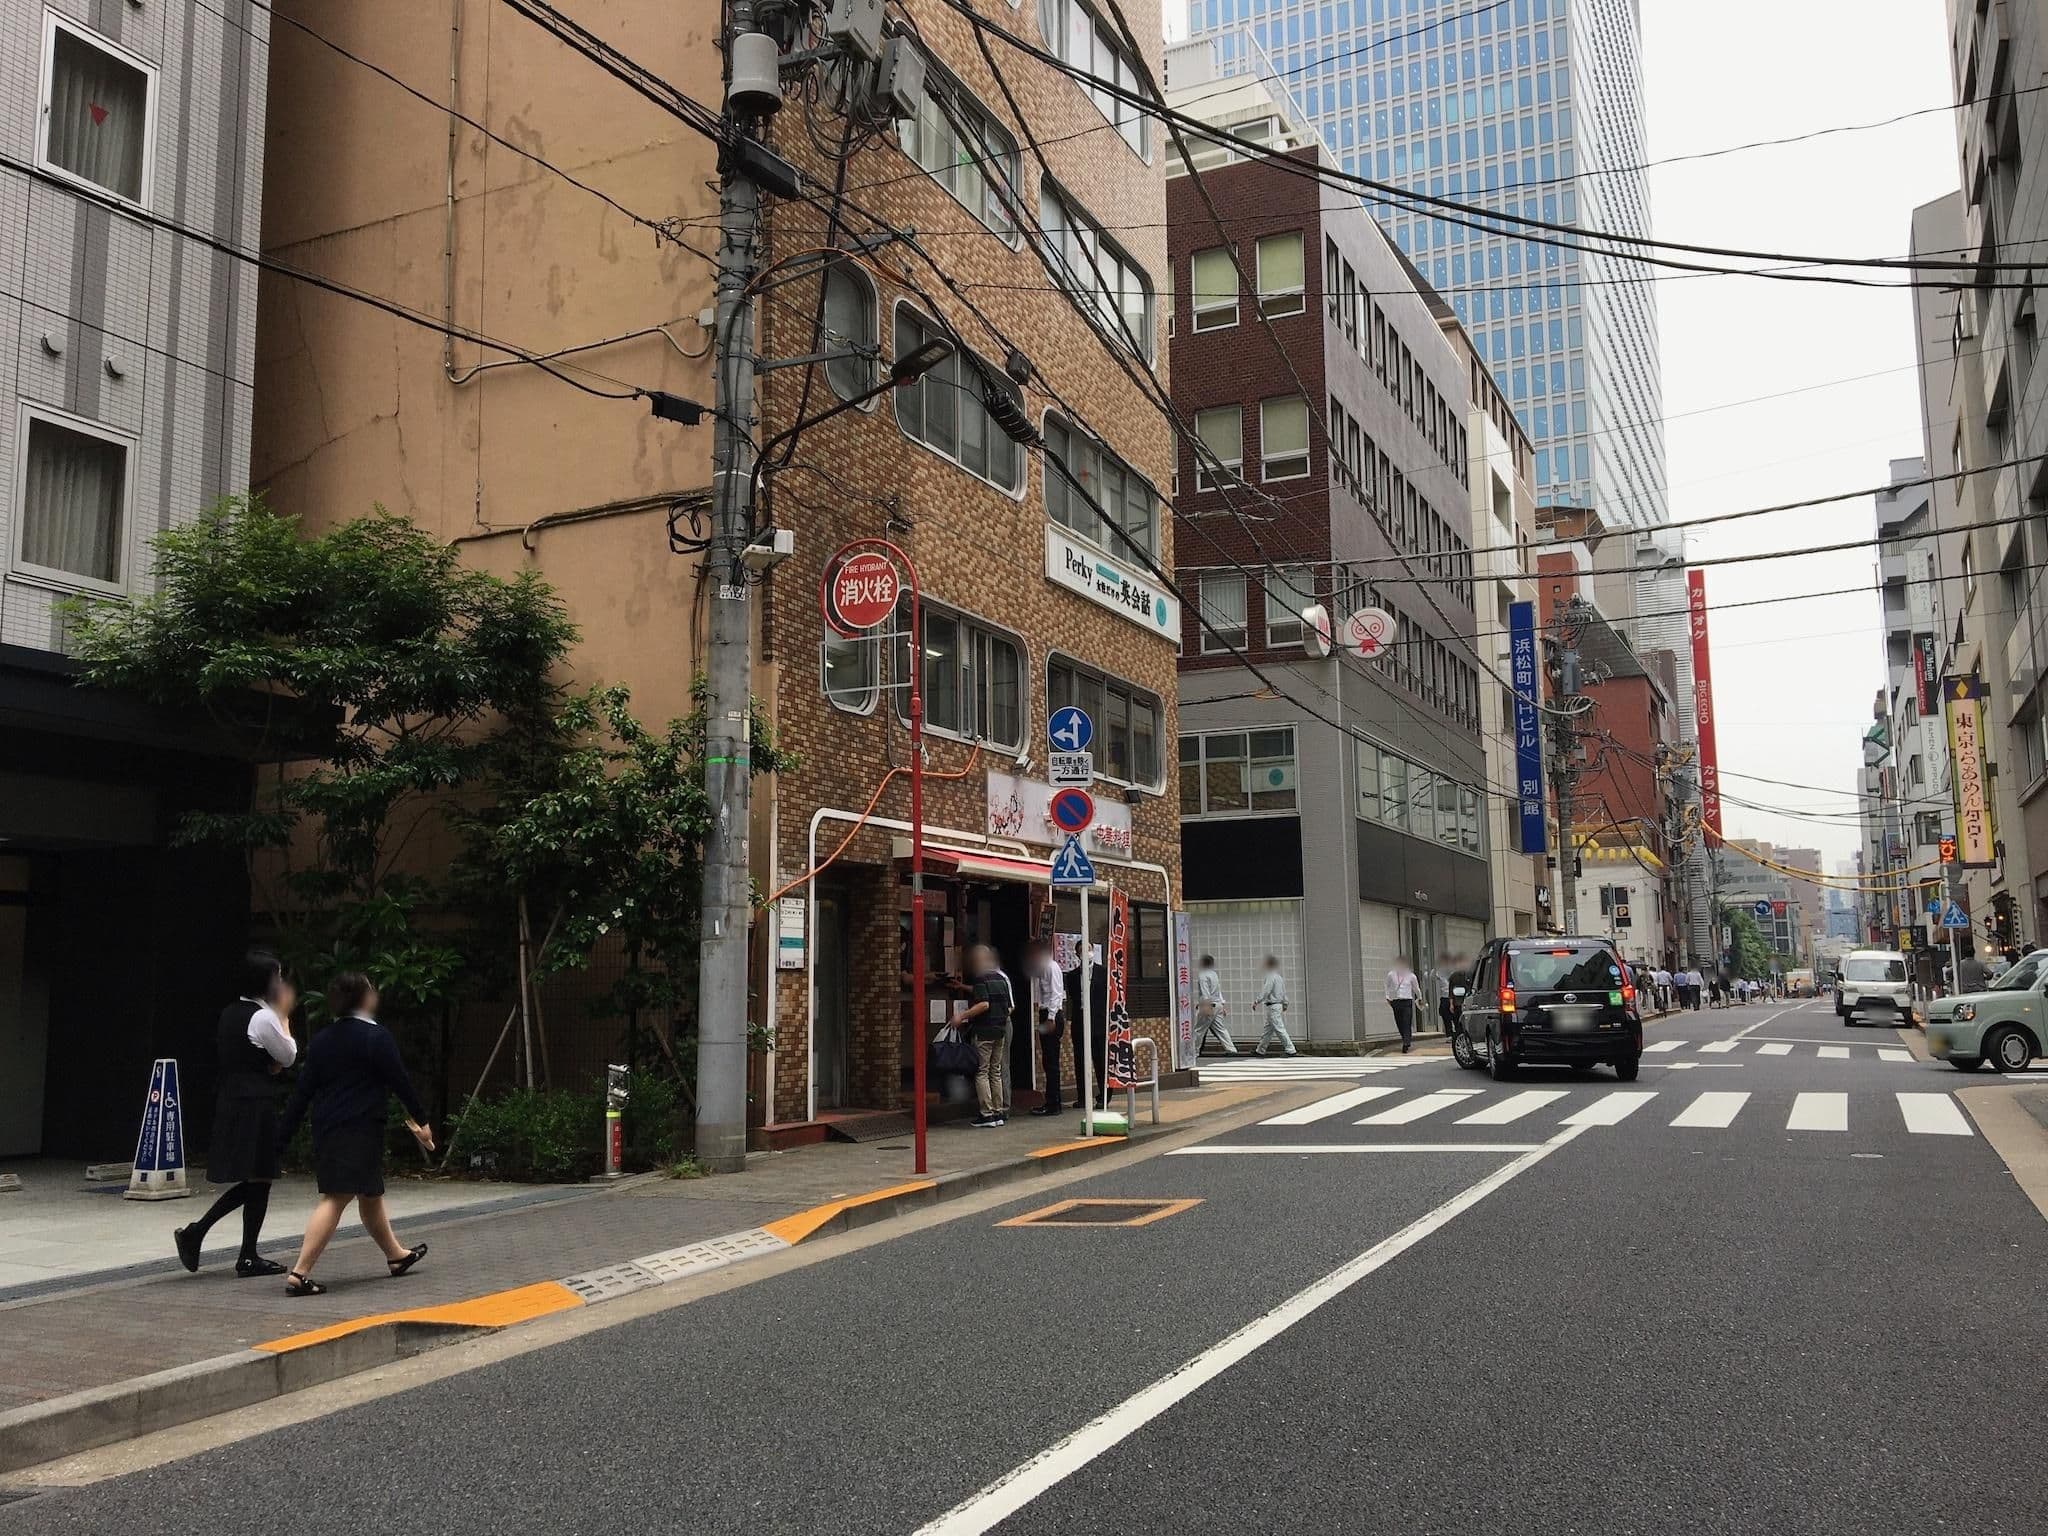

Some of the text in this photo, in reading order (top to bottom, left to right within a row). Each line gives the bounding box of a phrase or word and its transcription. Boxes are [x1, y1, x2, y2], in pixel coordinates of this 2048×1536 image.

[845, 561, 887, 574] FIRE HYDRANT
[1065, 546, 1093, 587] Perky
[840, 574, 893, 606] 消火栓
[1120, 579, 1151, 616] 英会話
[1692, 588, 1705, 640] カラオケ
[1697, 679, 1709, 724] BIG ECHO
[1928, 721, 1936, 750] RAMEN
[1051, 766, 1089, 775] 一方通行
[1522, 779, 1539, 816] 別館
[1703, 764, 1718, 820] カラオケ
[1096, 824, 1131, 849] 中華料理
